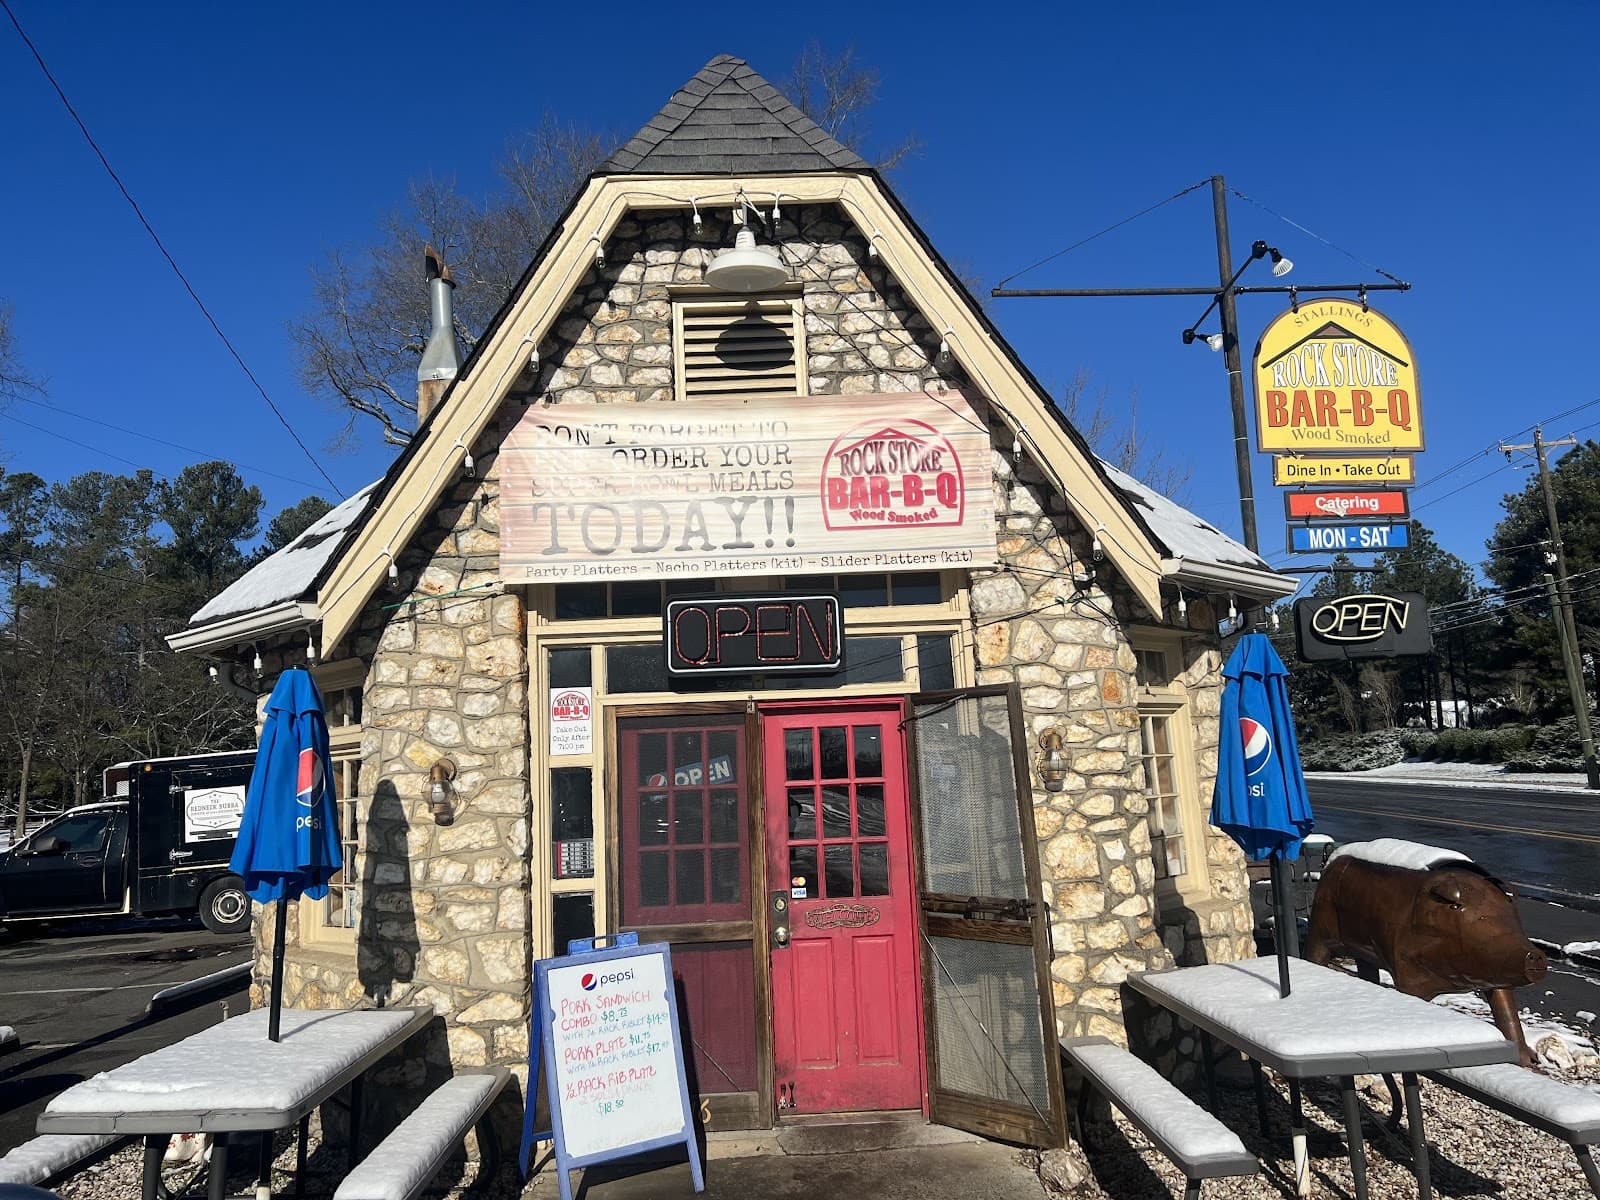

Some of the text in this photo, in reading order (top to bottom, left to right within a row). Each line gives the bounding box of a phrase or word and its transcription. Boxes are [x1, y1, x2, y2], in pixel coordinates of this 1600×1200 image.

[1295, 306, 1373, 327] STALLINGS
[1272, 343, 1399, 388] ROCK STORE
[1266, 389, 1412, 431] BAR-B-Q
[1291, 428, 1391, 444] Wood Smoked
[718, 444, 793, 467] YOUR
[840, 440, 943, 476] ROCK STORE
[709, 470, 794, 492] MEALS
[1287, 463, 1401, 476] Dine In Take Out
[828, 472, 958, 510] BAR-B-Q
[850, 508, 938, 523] Wood Smoked
[1315, 496, 1379, 511] Catering
[531, 496, 795, 556] TODAY!!
[1309, 528, 1346, 548] MON
[1359, 527, 1390, 547] SAT
[526, 566, 568, 578] Party
[572, 564, 638, 576] Platters
[656, 561, 699, 573] Nacho
[703, 559, 767, 571] Platters
[771, 557, 803, 570] (kit)
[821, 555, 870, 567] Slider
[875, 553, 937, 565] Platters
[941, 550, 973, 562] (kit)
[1312, 601, 1410, 633] OPEN
[674, 601, 833, 666] OPEN
[675, 760, 730, 786] OPEN
[600, 968, 634, 987] pepsi
[561, 990, 651, 1016] PORK SANDWICH
[561, 1013, 597, 1031] COMBO
[564, 1045, 594, 1064] PORK
[596, 1036, 627, 1055] PLATE
[577, 1075, 606, 1095] RACK
